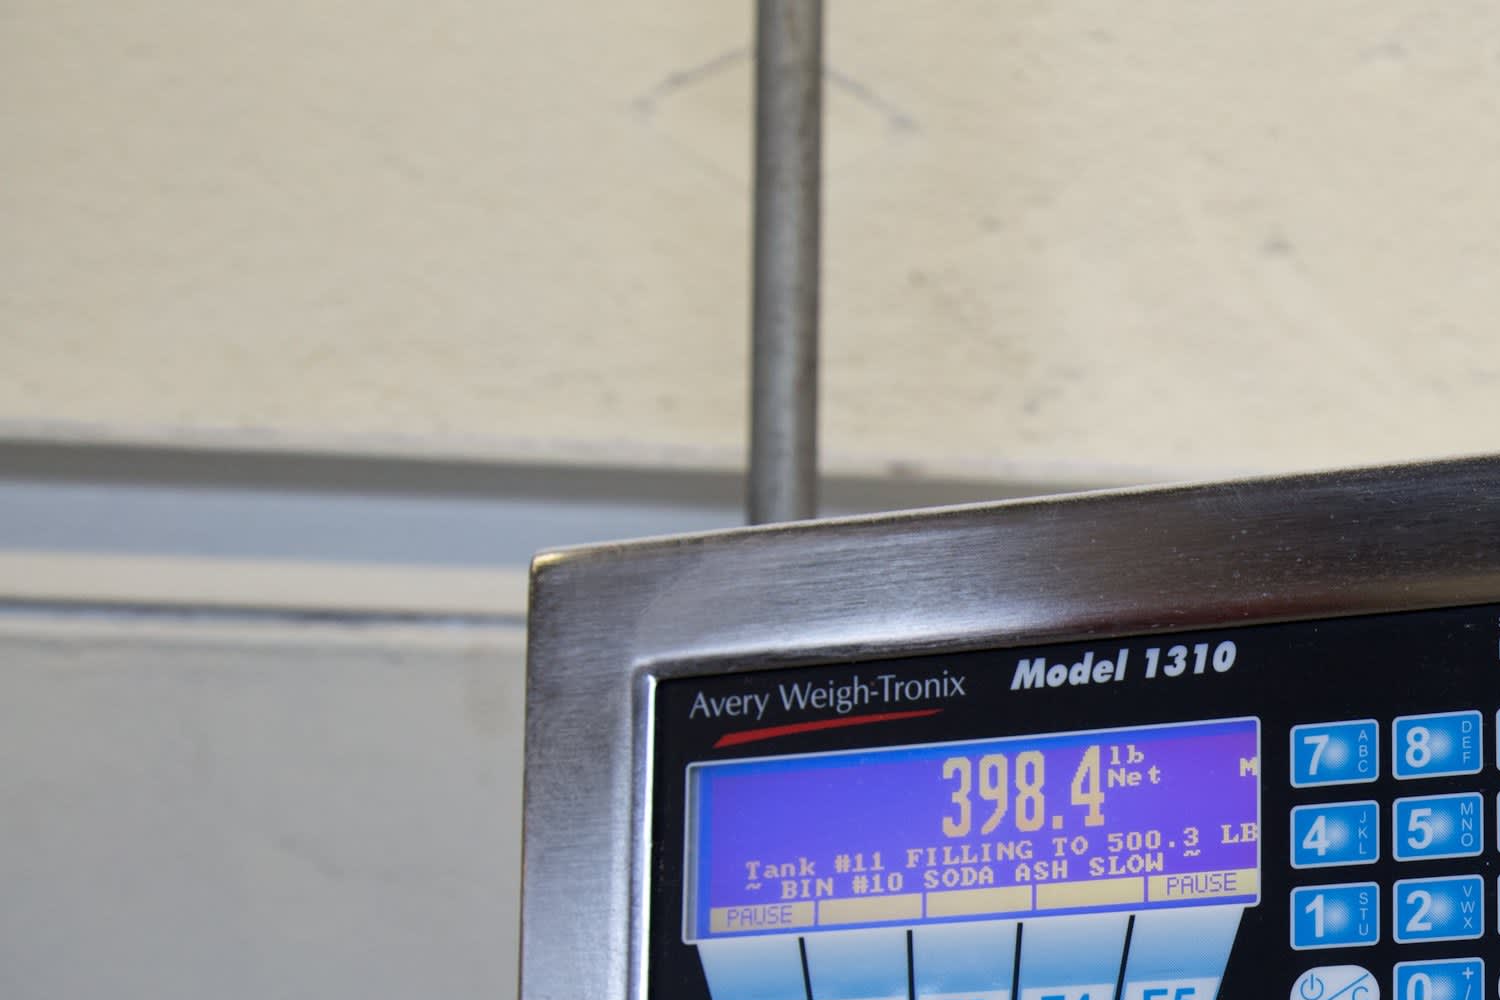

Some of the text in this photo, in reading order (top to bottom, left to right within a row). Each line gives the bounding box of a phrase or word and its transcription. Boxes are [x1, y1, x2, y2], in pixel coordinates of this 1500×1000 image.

[1010, 641, 1237, 690] Model 1310
[689, 670, 966, 720] Avery Weigh-Tronix
[1110, 745, 1144, 765] lb
[1303, 734, 1329, 775] 7
[1405, 726, 1431, 768] 8
[941, 745, 1105, 837] 398.4
[1107, 766, 1160, 788] Net
[1302, 815, 1329, 856] 4
[1407, 807, 1433, 849] 5
[746, 822, 1257, 880] Tank #11 FILLING TO 500.3 LB
[781, 878, 834, 900] BIN
[852, 872, 903, 895] #10
[924, 866, 994, 889] SODA
[1015, 860, 1068, 882] ASH
[1089, 852, 1164, 876] SLOW
[1166, 872, 1237, 895] PAUSE
[727, 905, 793, 928] PAUSE
[1305, 894, 1325, 938] 1
[1406, 890, 1433, 933] 2
